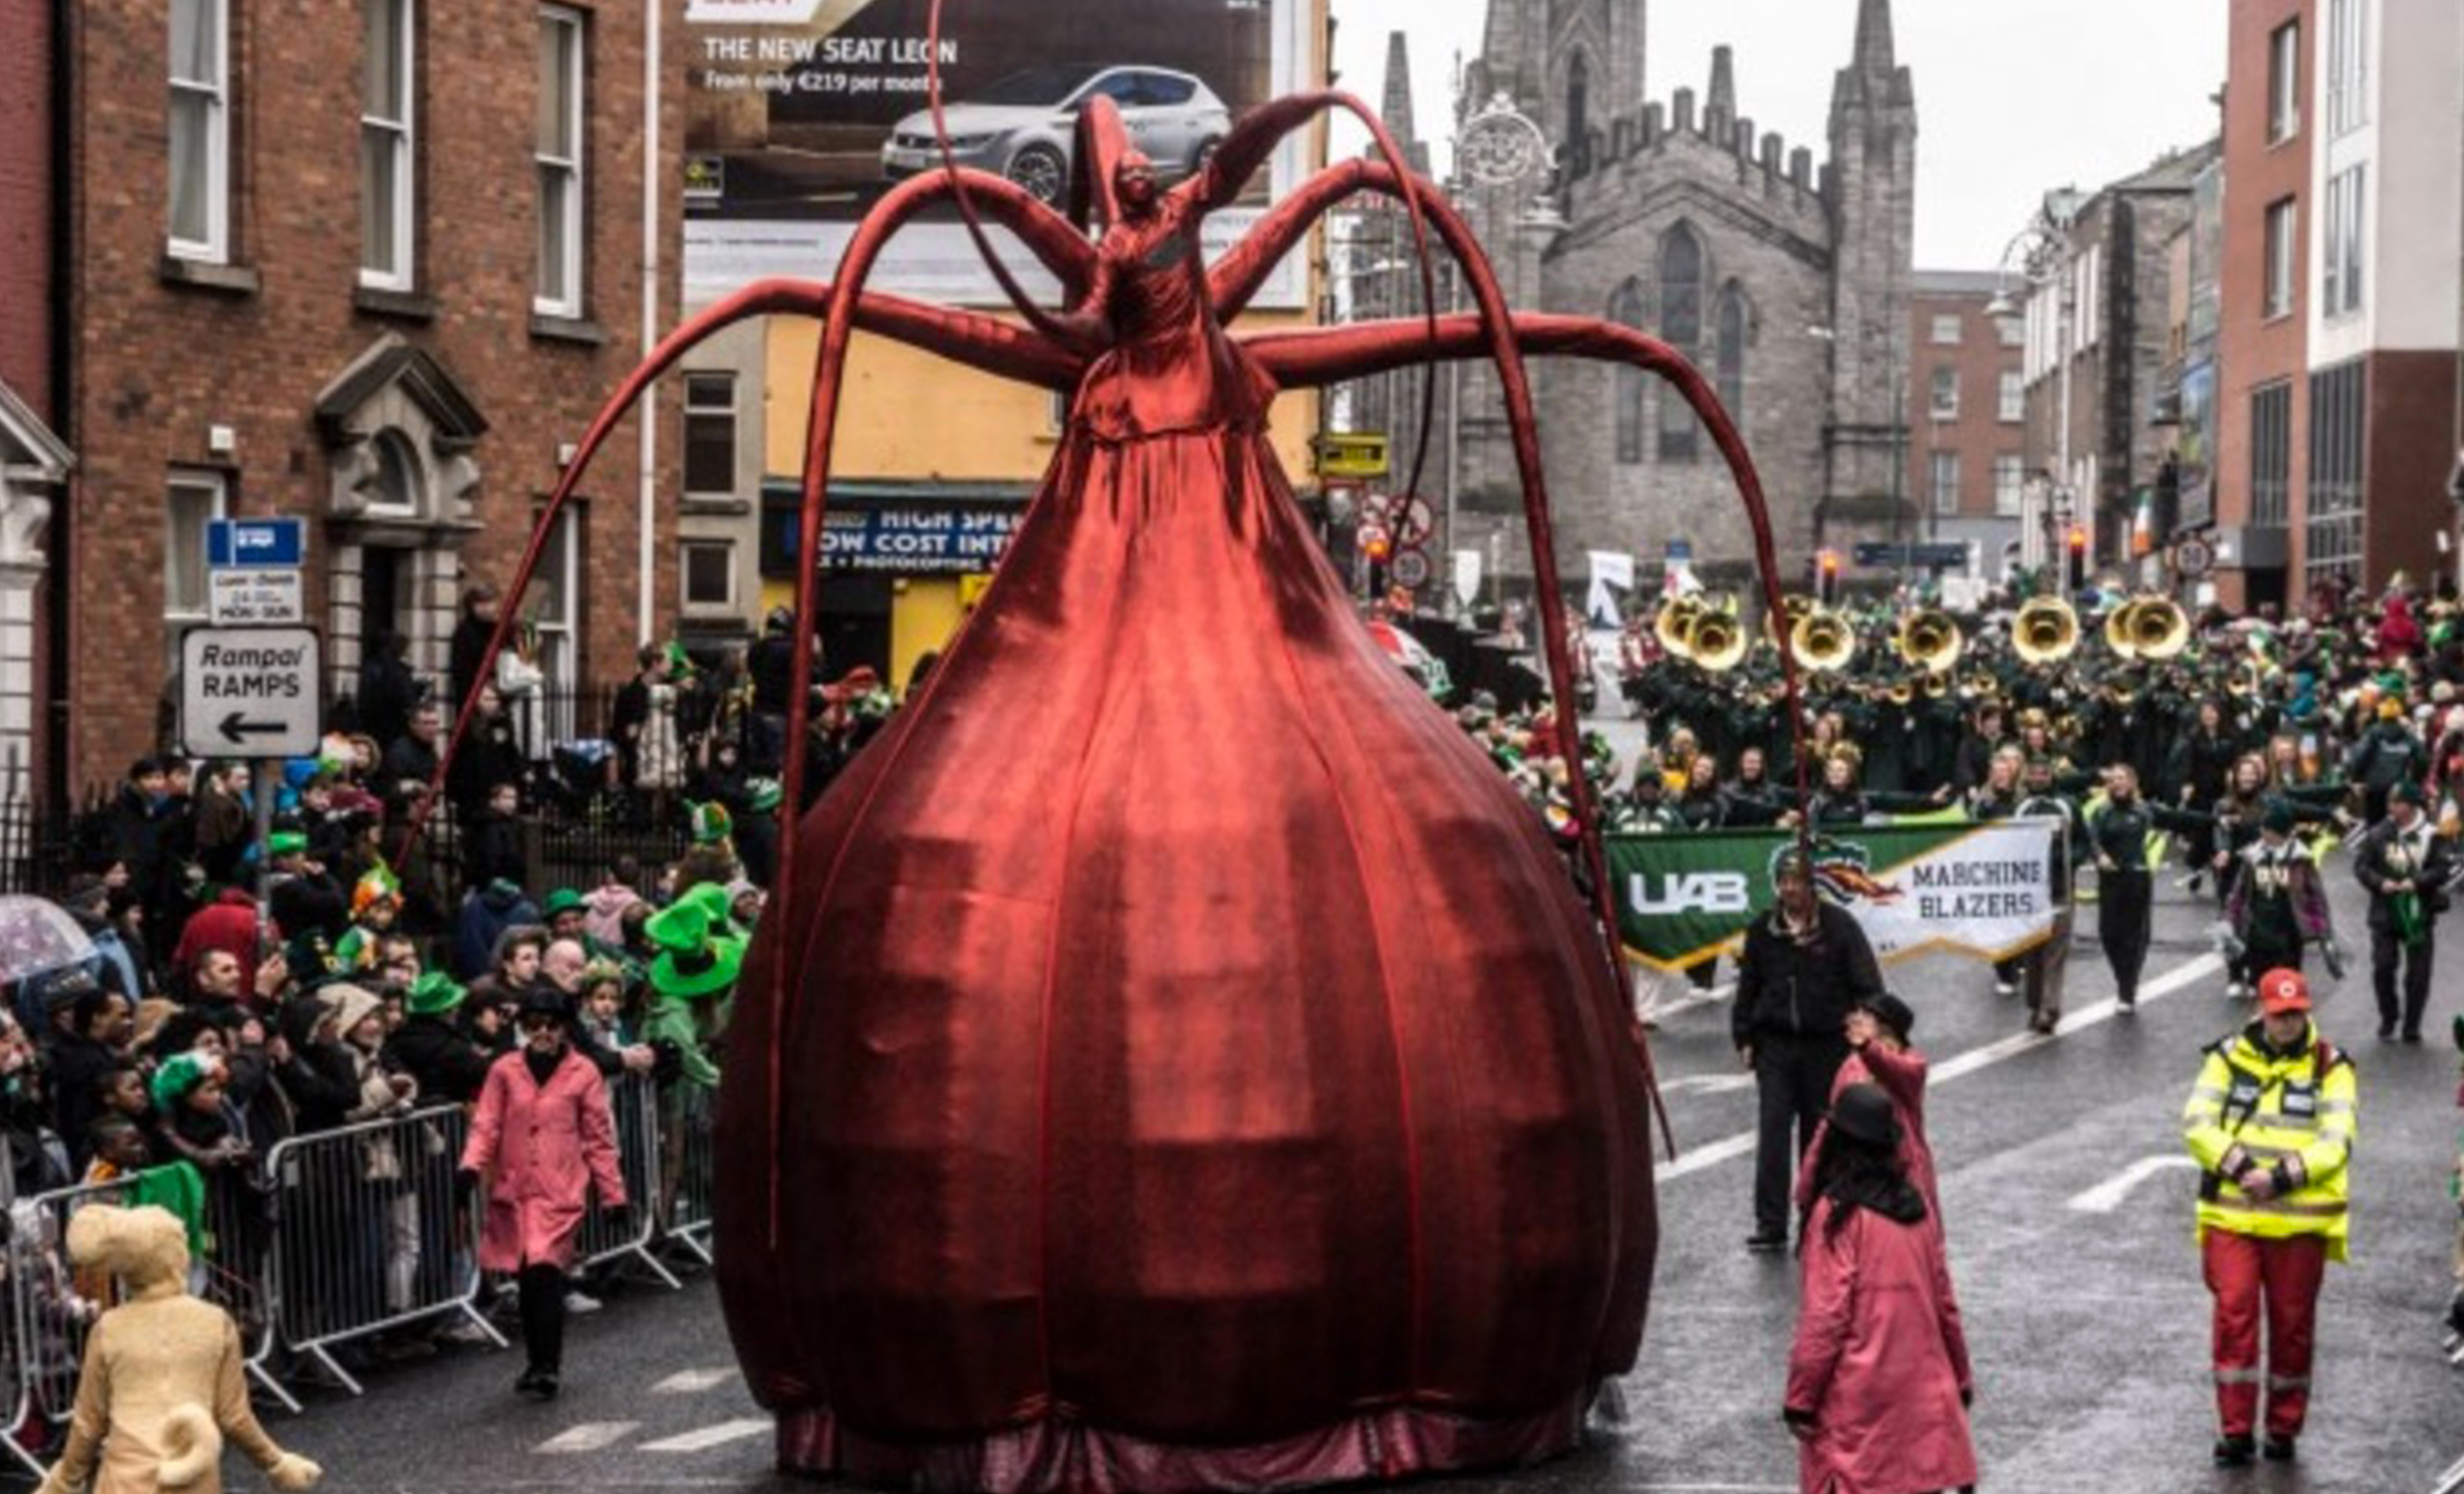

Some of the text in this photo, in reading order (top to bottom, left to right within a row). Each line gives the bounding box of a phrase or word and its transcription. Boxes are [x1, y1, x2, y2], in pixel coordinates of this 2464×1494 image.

[705, 37, 752, 62] THE
[758, 37, 815, 62] NEW
[822, 37, 886, 63] SEAT
[798, 73, 847, 92] €219
[851, 77, 880, 95] per
[874, 533, 949, 553] COST
[203, 673, 300, 698] RAMPS
[1629, 873, 1748, 915] UAB
[1920, 893, 2033, 917] BLAZERS
